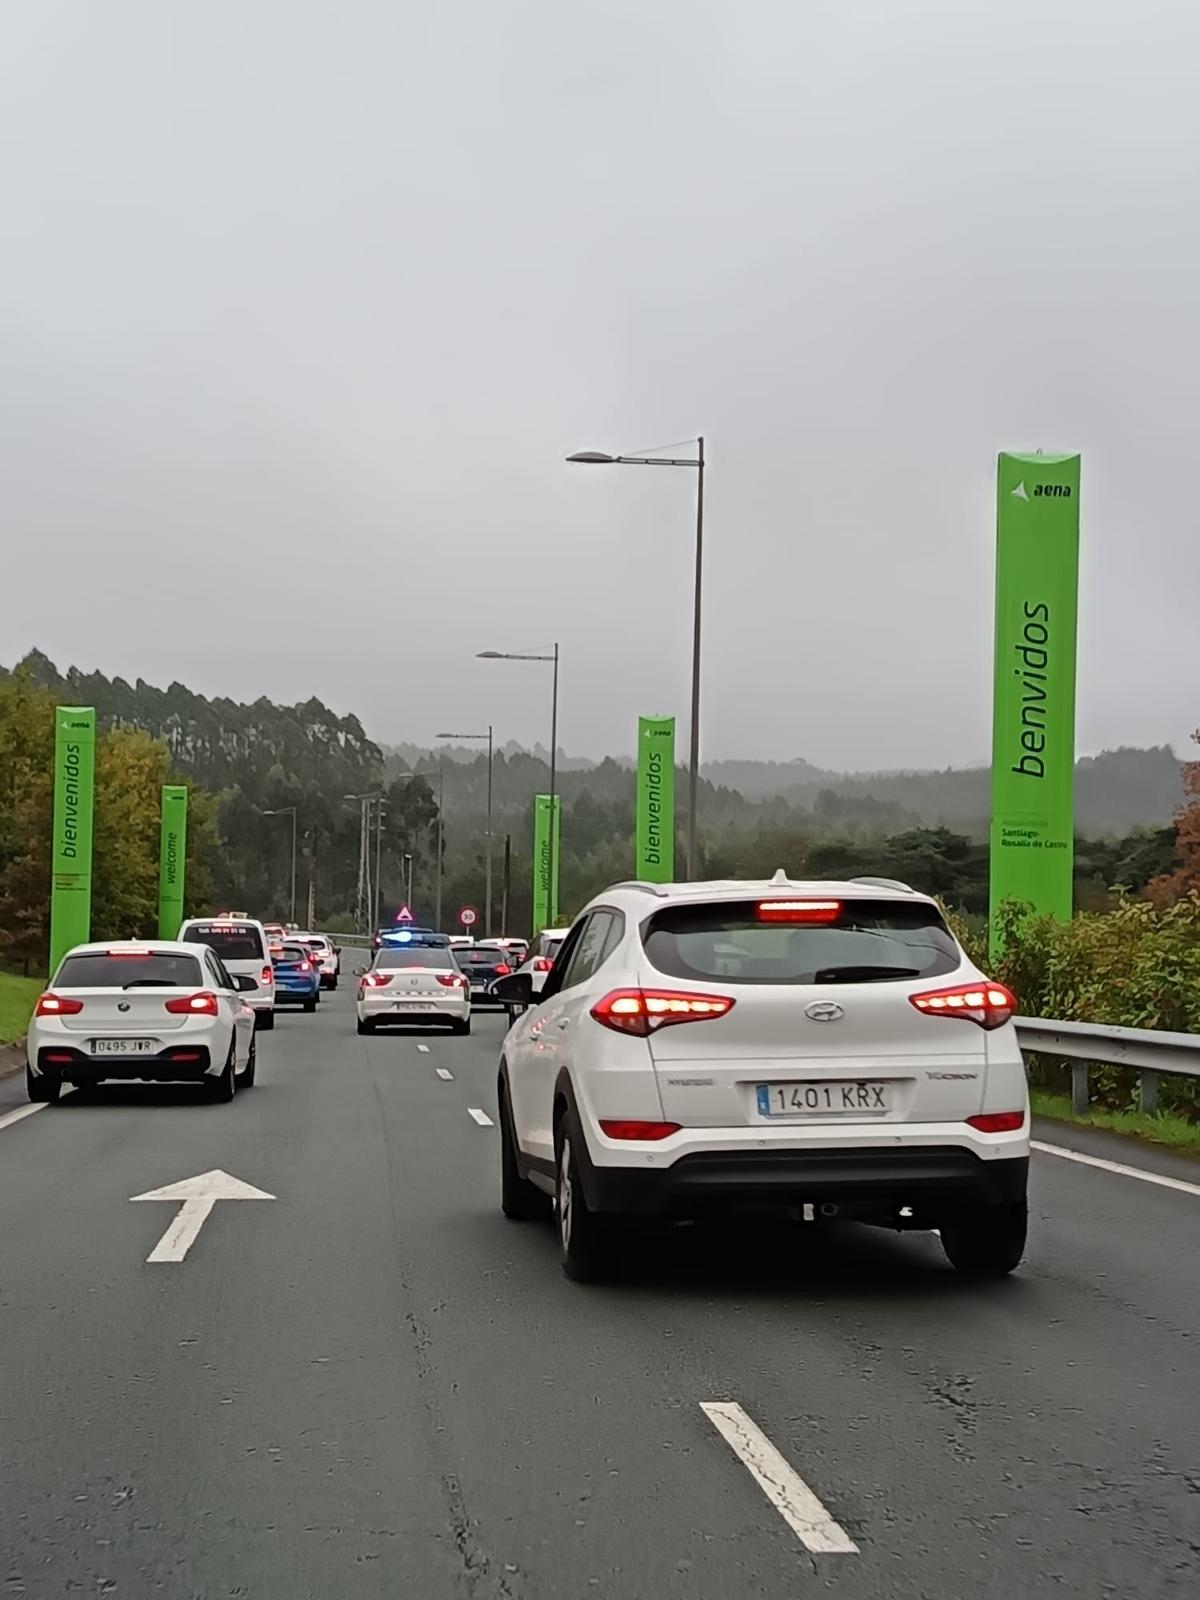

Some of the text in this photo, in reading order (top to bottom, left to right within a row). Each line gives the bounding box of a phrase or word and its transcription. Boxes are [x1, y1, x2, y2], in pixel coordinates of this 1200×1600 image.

[1033, 484, 1072, 497] aena
[1011, 601, 1049, 779] benvidos
[61, 743, 80, 858] bienvenidos
[644, 752, 661, 865] bienvenidos
[167, 832, 177, 884] welcome
[1044, 839, 1068, 849] Castro
[537, 839, 551, 891] welcome
[463, 913, 474, 921] 30
[98, 1041, 127, 1052] 0495
[777, 1086, 887, 1110] 1401 KRX
